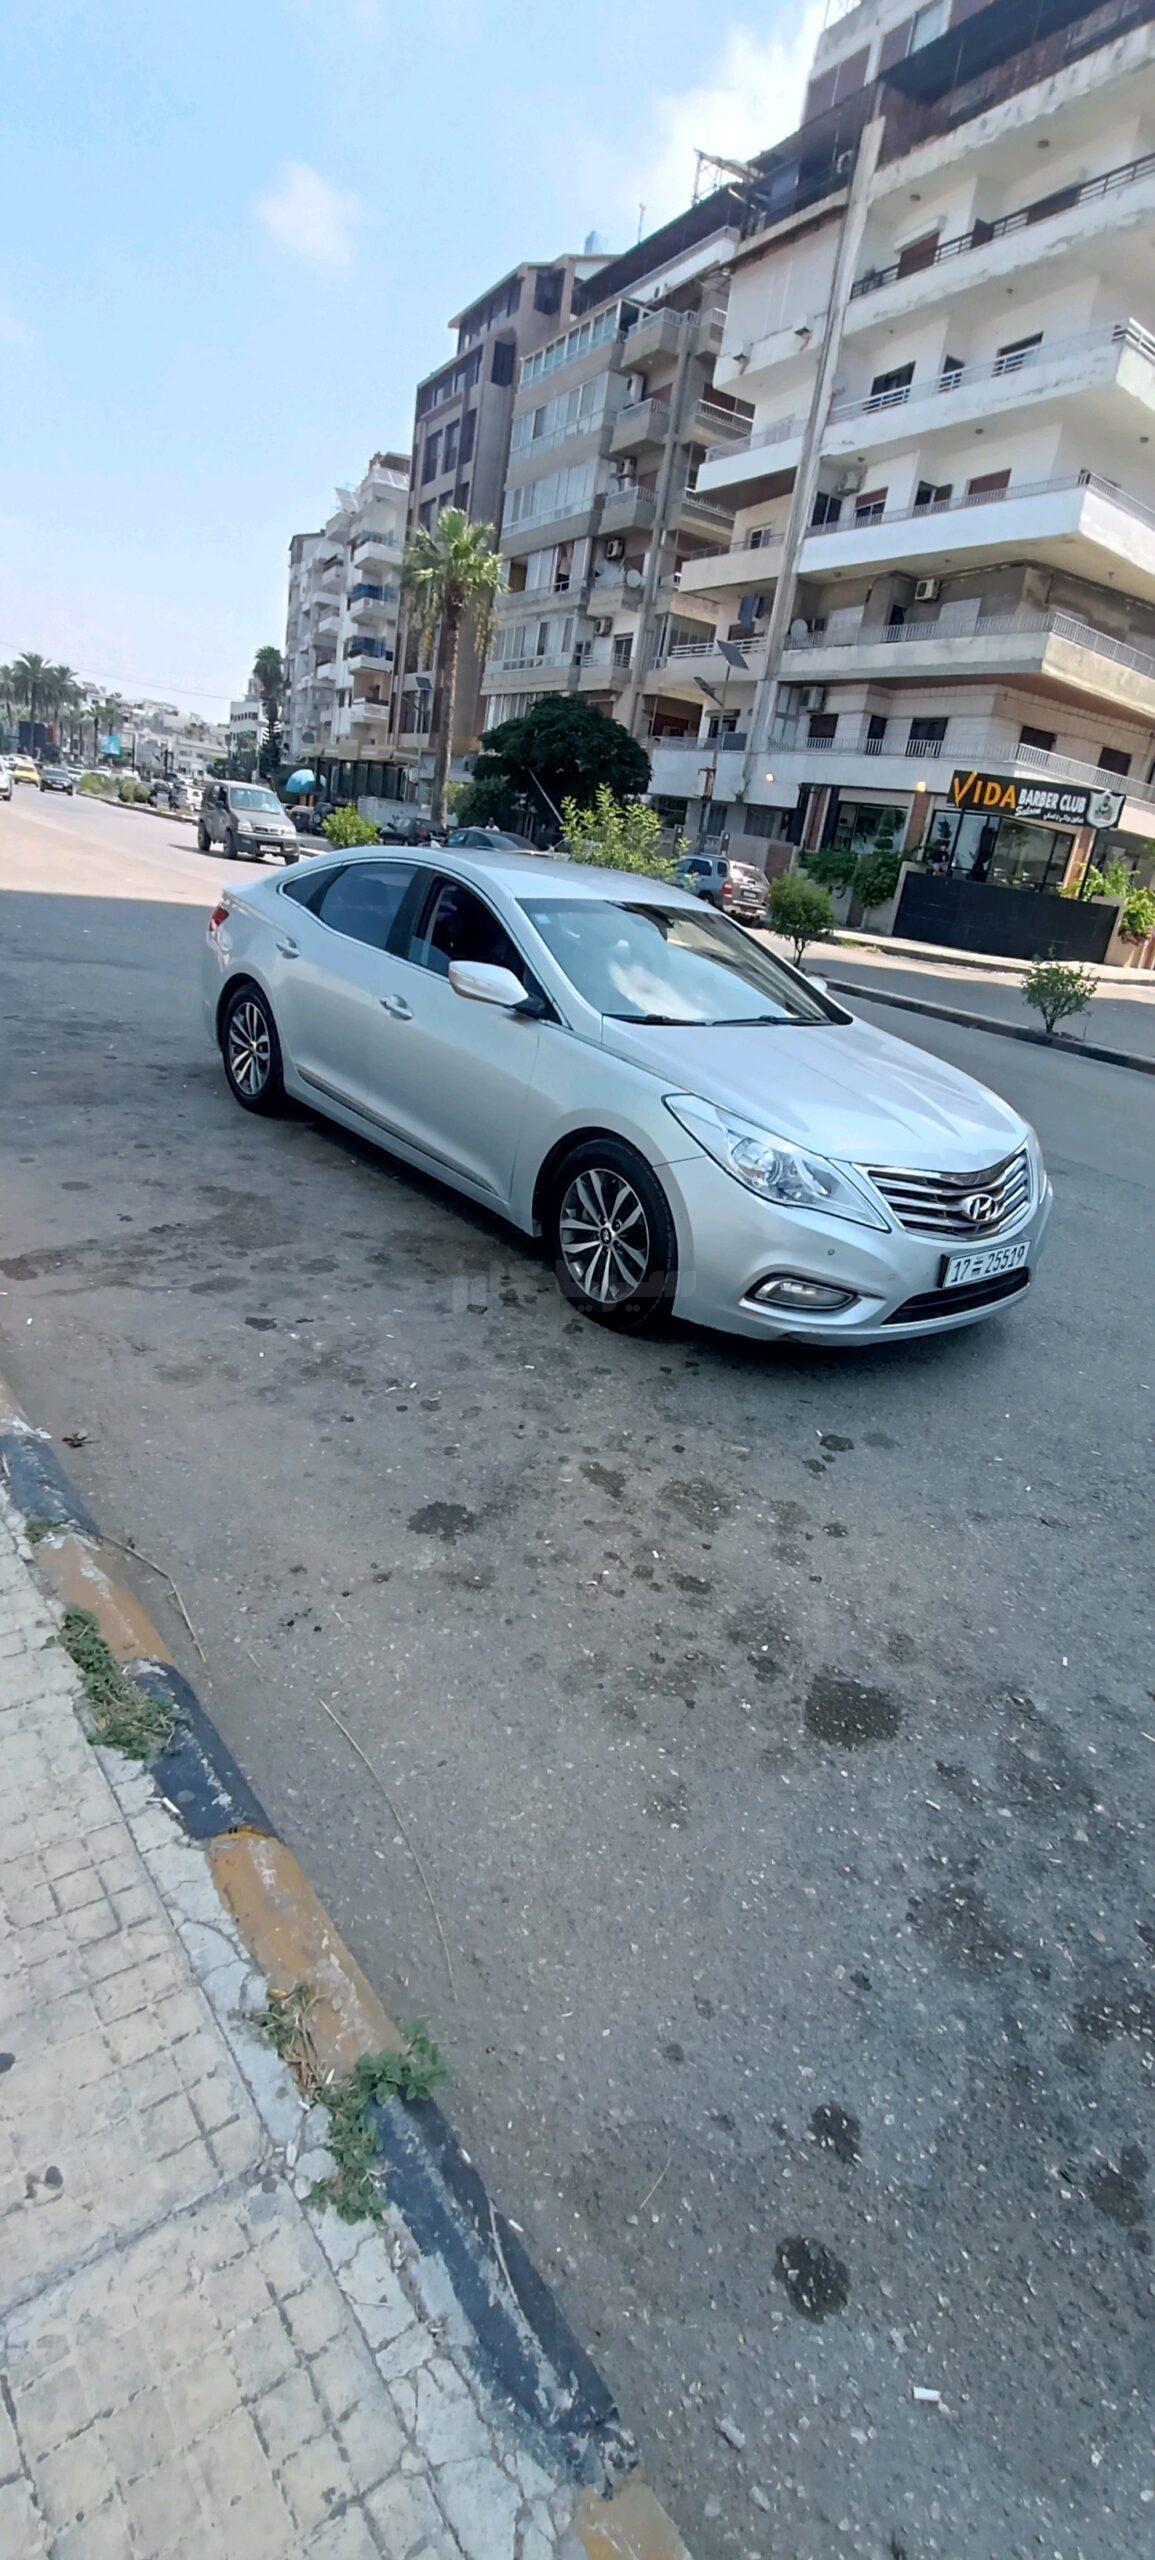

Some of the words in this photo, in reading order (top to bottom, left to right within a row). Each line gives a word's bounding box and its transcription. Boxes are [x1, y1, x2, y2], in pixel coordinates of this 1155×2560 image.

[953, 771, 1016, 808] VIDA
[1018, 788, 1060, 810] BARBER
[1060, 795, 1086, 813] CLUB
[950, 1259, 971, 1283] 17
[985, 1245, 1026, 1274] 25519
